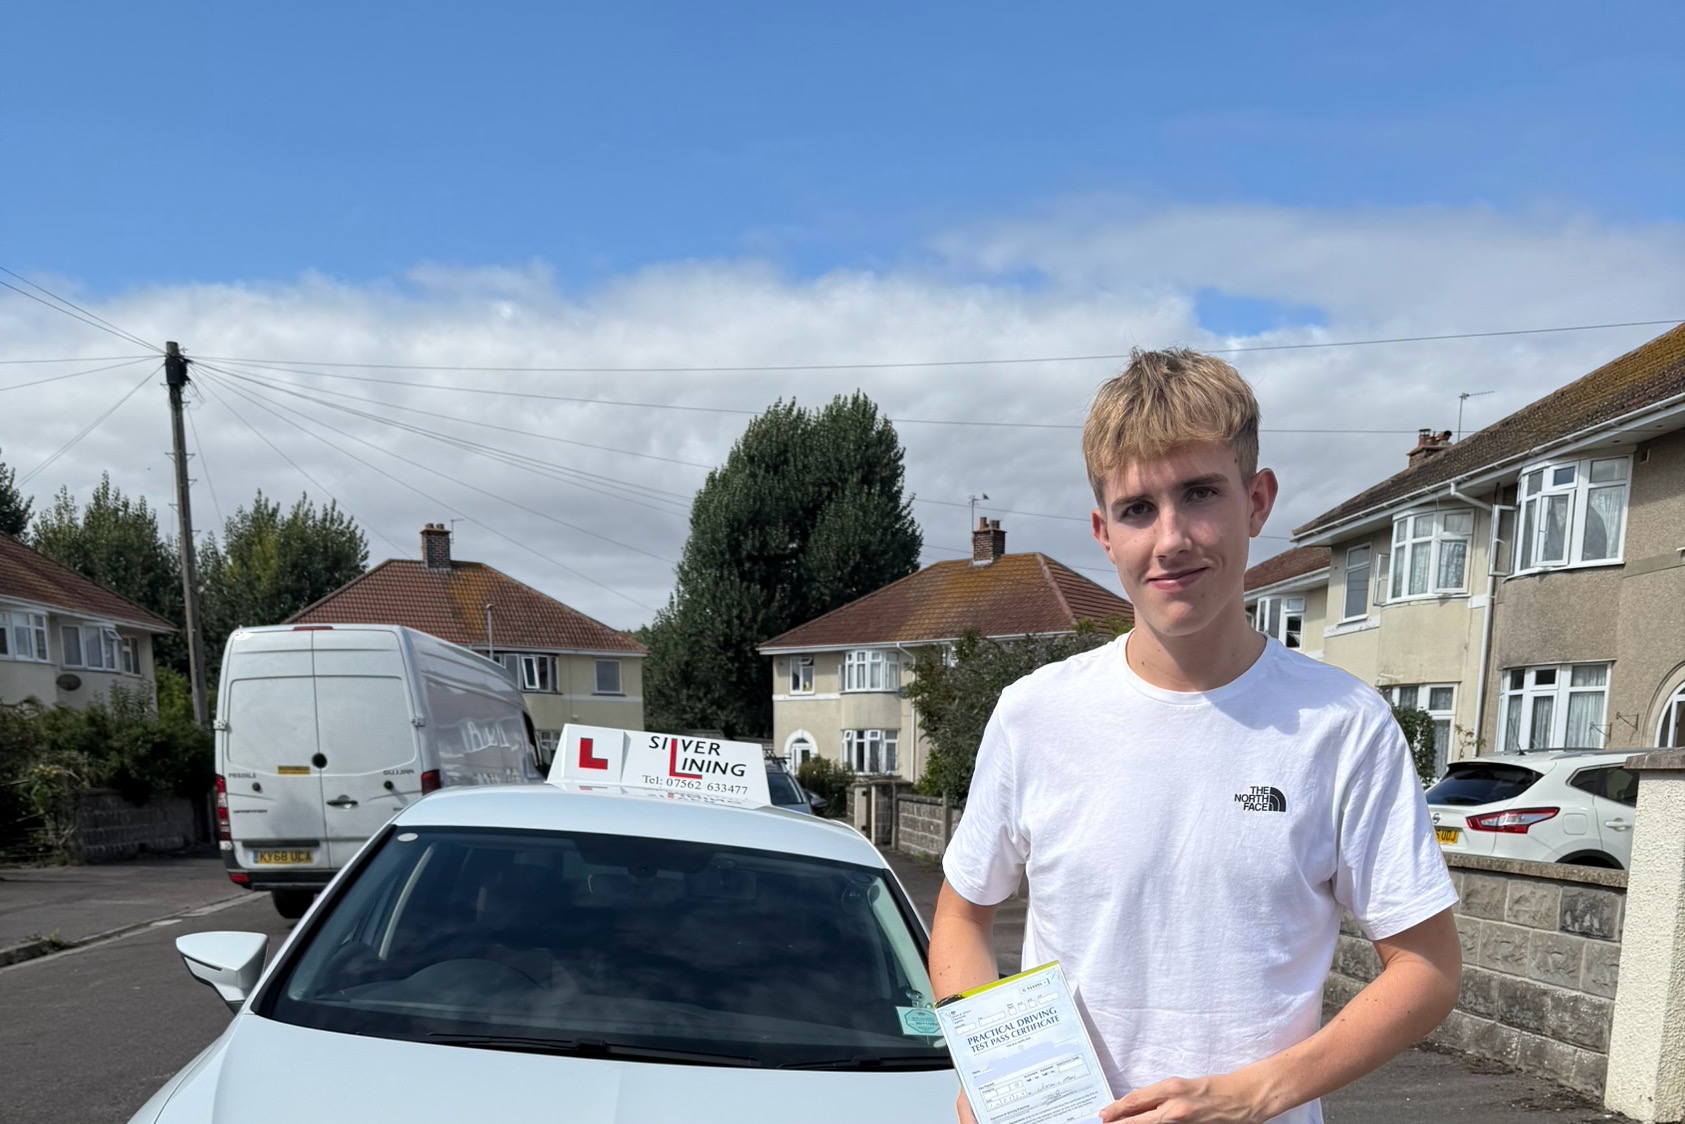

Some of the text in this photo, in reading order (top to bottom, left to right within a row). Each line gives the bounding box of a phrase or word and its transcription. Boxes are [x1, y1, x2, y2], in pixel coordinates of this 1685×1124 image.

[579, 737, 608, 770] L
[649, 735, 721, 757] SILVER
[669, 738, 747, 780] LINING
[642, 774, 748, 795] Tel: 07562 633477
[1250, 786, 1270, 795] THE
[1234, 793, 1270, 803] NORTH
[1243, 802, 1268, 811] FACE
[967, 1022, 1016, 1046] PRACTICAL
[1016, 1007, 1058, 1028] DRIVING
[971, 1040, 990, 1053] TEST
[991, 1032, 1010, 1046] PASS
[1011, 1015, 1061, 1038] CERTIFICATE
